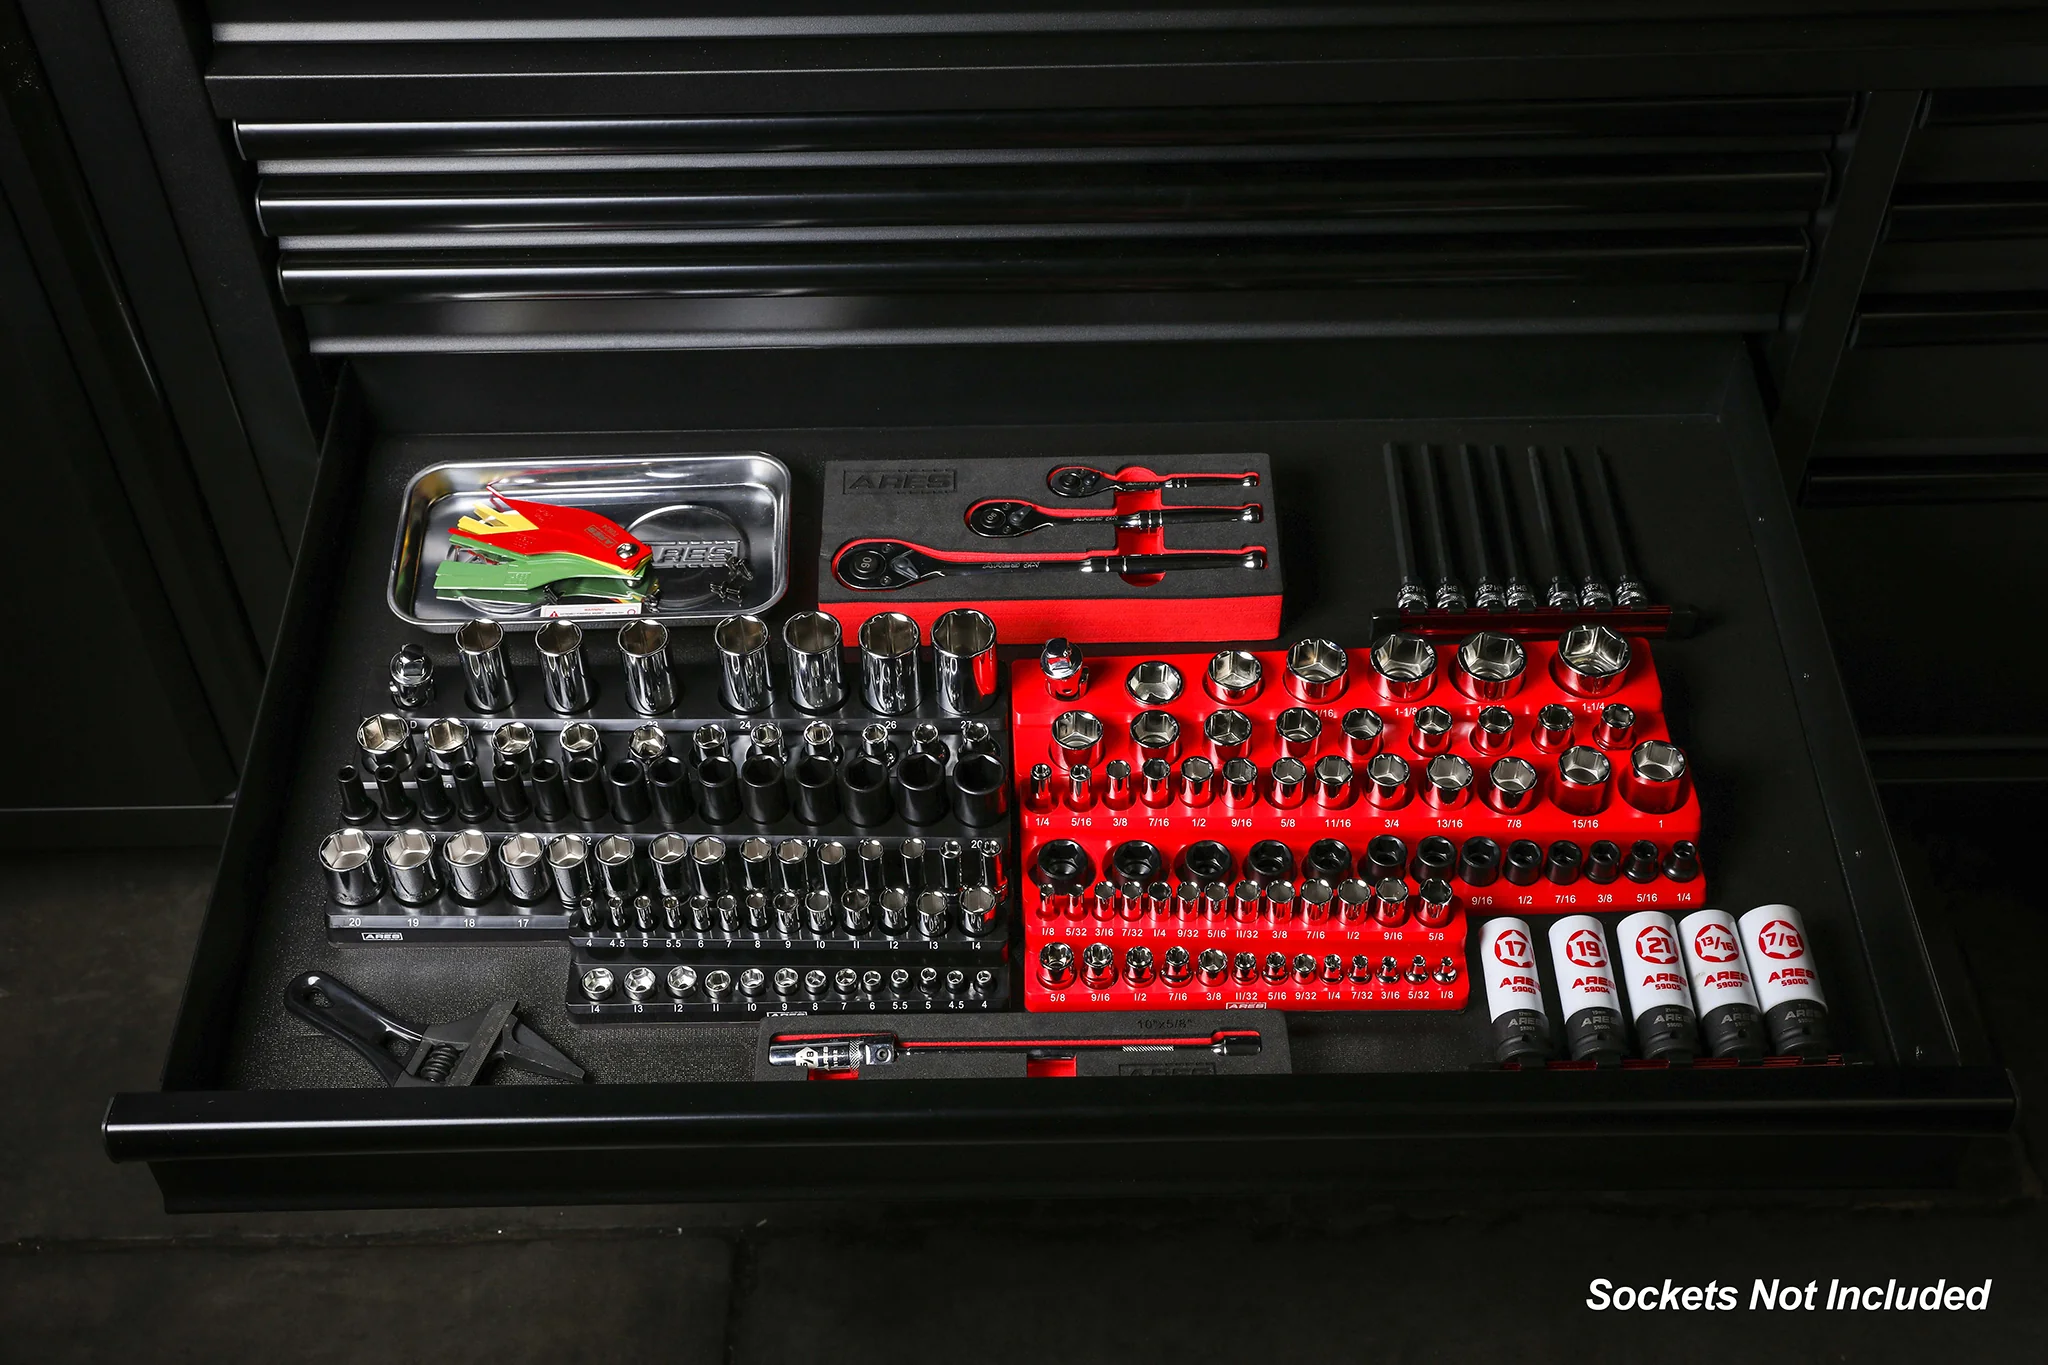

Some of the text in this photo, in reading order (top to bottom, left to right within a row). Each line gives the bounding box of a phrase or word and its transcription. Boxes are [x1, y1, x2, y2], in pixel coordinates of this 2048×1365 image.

[849, 474, 951, 489] ARES
[653, 546, 733, 563] RES
[1582, 703, 1605, 711] 1-1/4
[482, 720, 493, 728] 21
[739, 721, 751, 729] 24
[885, 721, 897, 729] 26
[1035, 818, 1050, 827] 1/4
[1071, 818, 1092, 827] 5/16
[1112, 818, 1128, 827] 3/8
[1148, 818, 1170, 828] 7/16
[1191, 819, 1207, 828] 1/2
[1231, 819, 1253, 828] 9/16
[1280, 819, 1296, 828] 5/8
[1325, 819, 1352, 828] 11/16
[1384, 819, 1400, 828] 3/4
[1436, 820, 1463, 828] 13/16
[1506, 820, 1522, 829] 7/8
[1572, 820, 1599, 829] 15/16
[1658, 820, 1663, 829] 1
[806, 839, 818, 848] 17
[1471, 896, 1493, 905] 9/16
[1518, 895, 1533, 904] 1/2
[1555, 895, 1577, 904] 7/16
[1597, 894, 1613, 903] 3/8
[1636, 894, 1658, 903] 5/16
[1676, 893, 1691, 902] 1/4
[348, 918, 362, 928] 20
[407, 918, 420, 928] 19
[463, 919, 476, 929] 18
[517, 919, 530, 929] 17
[1042, 928, 1055, 936] 1/8
[1065, 928, 1088, 936] 5/32
[1094, 929, 1114, 937] 3/16
[1121, 929, 1144, 937] 7/32
[1153, 929, 1167, 937] 1/4
[1177, 930, 1199, 938] 9/32
[1207, 930, 1227, 938] 5/16
[1236, 930, 1259, 938] 11/32
[1272, 931, 1288, 939] 3/8
[1306, 931, 1326, 939] 7/16
[1347, 931, 1360, 939] 1/2
[1383, 932, 1403, 940] 9/16
[1428, 932, 1444, 940] 5/8
[586, 939, 593, 948] 4
[609, 939, 626, 948] 4.5
[642, 939, 649, 948] 5
[665, 940, 682, 948] 5.5
[697, 940, 704, 949] 6
[726, 940, 732, 949] 7
[754, 940, 761, 949] 8
[785, 940, 792, 949] 9
[816, 940, 826, 949] 10
[1701, 936, 1734, 951] 13/16
[1766, 932, 1799, 948] 7/8
[853, 940, 860, 950] 11
[889, 941, 899, 950] 12
[929, 941, 939, 950] 13
[971, 941, 981, 950] 14
[1505, 941, 1527, 957] 17
[1576, 941, 1601, 957] 19
[1647, 937, 1671, 954] 21
[1717, 981, 1742, 989] 59007
[1781, 978, 1809, 986] 59006
[1381, 991, 1401, 999] 3/16
[1407, 991, 1430, 999] 5/32
[1440, 991, 1454, 999] 1/8
[1512, 986, 1536, 995] 59003
[1584, 986, 1610, 995] 59004
[1050, 993, 1066, 1001] 5/8
[1091, 993, 1111, 1001] 9/16
[1134, 993, 1147, 1001] 1/2
[1168, 992, 1188, 1000] 7/16
[1206, 992, 1222, 1000] 3/8
[1235, 992, 1258, 1000] 11/32
[1267, 992, 1287, 1000] 5/16
[1295, 992, 1317, 1000] 9/32
[1327, 992, 1341, 1000] 1/4
[1351, 992, 1373, 1000] 7/32
[590, 1004, 601, 1013] 14
[633, 1004, 644, 1013] 13
[673, 1003, 684, 1012] 12
[712, 1003, 720, 1012] 11
[747, 1003, 757, 1012] 10
[781, 1002, 788, 1011] 9
[812, 1002, 819, 1011] 8
[841, 1002, 847, 1011] 7
[869, 1001, 876, 1010] 6
[892, 1001, 908, 1010] 5.5
[925, 1001, 932, 1010] 5
[948, 1000, 965, 1009] 4.5
[981, 1000, 988, 1009] 4
